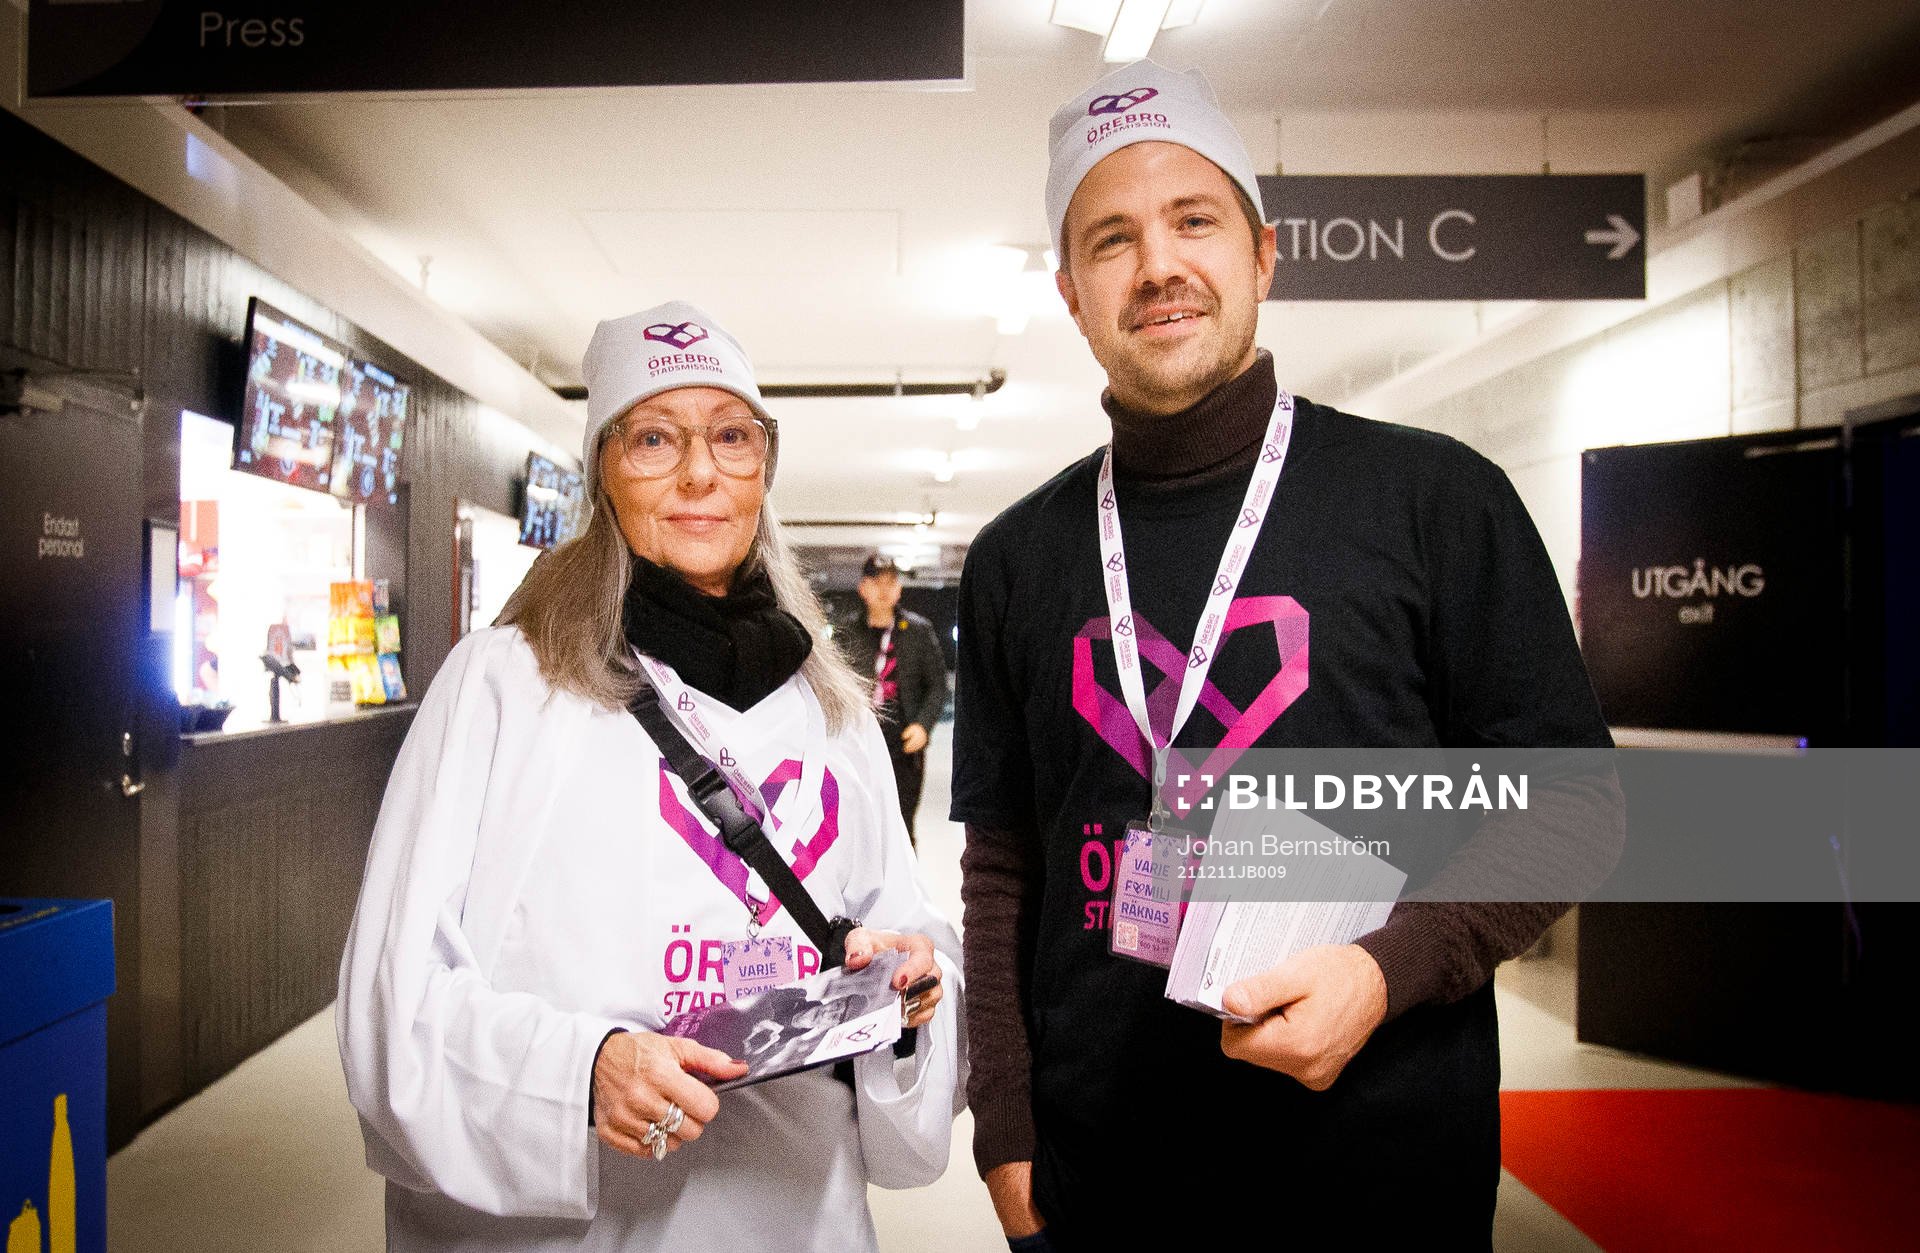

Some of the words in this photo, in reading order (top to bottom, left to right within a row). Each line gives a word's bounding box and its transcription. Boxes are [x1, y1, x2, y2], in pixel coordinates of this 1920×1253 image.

[200, 12, 304, 47] Press
[1087, 113, 1167, 143] ÖREBRO
[1429, 209, 1476, 261] C
[648, 354, 720, 369] ÖREBRO
[649, 364, 723, 378] STADSMISSION
[1632, 558, 1766, 598] UTGÅNG
[1134, 859, 1169, 877] VARJE
[1121, 900, 1169, 924] RÄKNAS
[738, 962, 778, 978] VARJE
